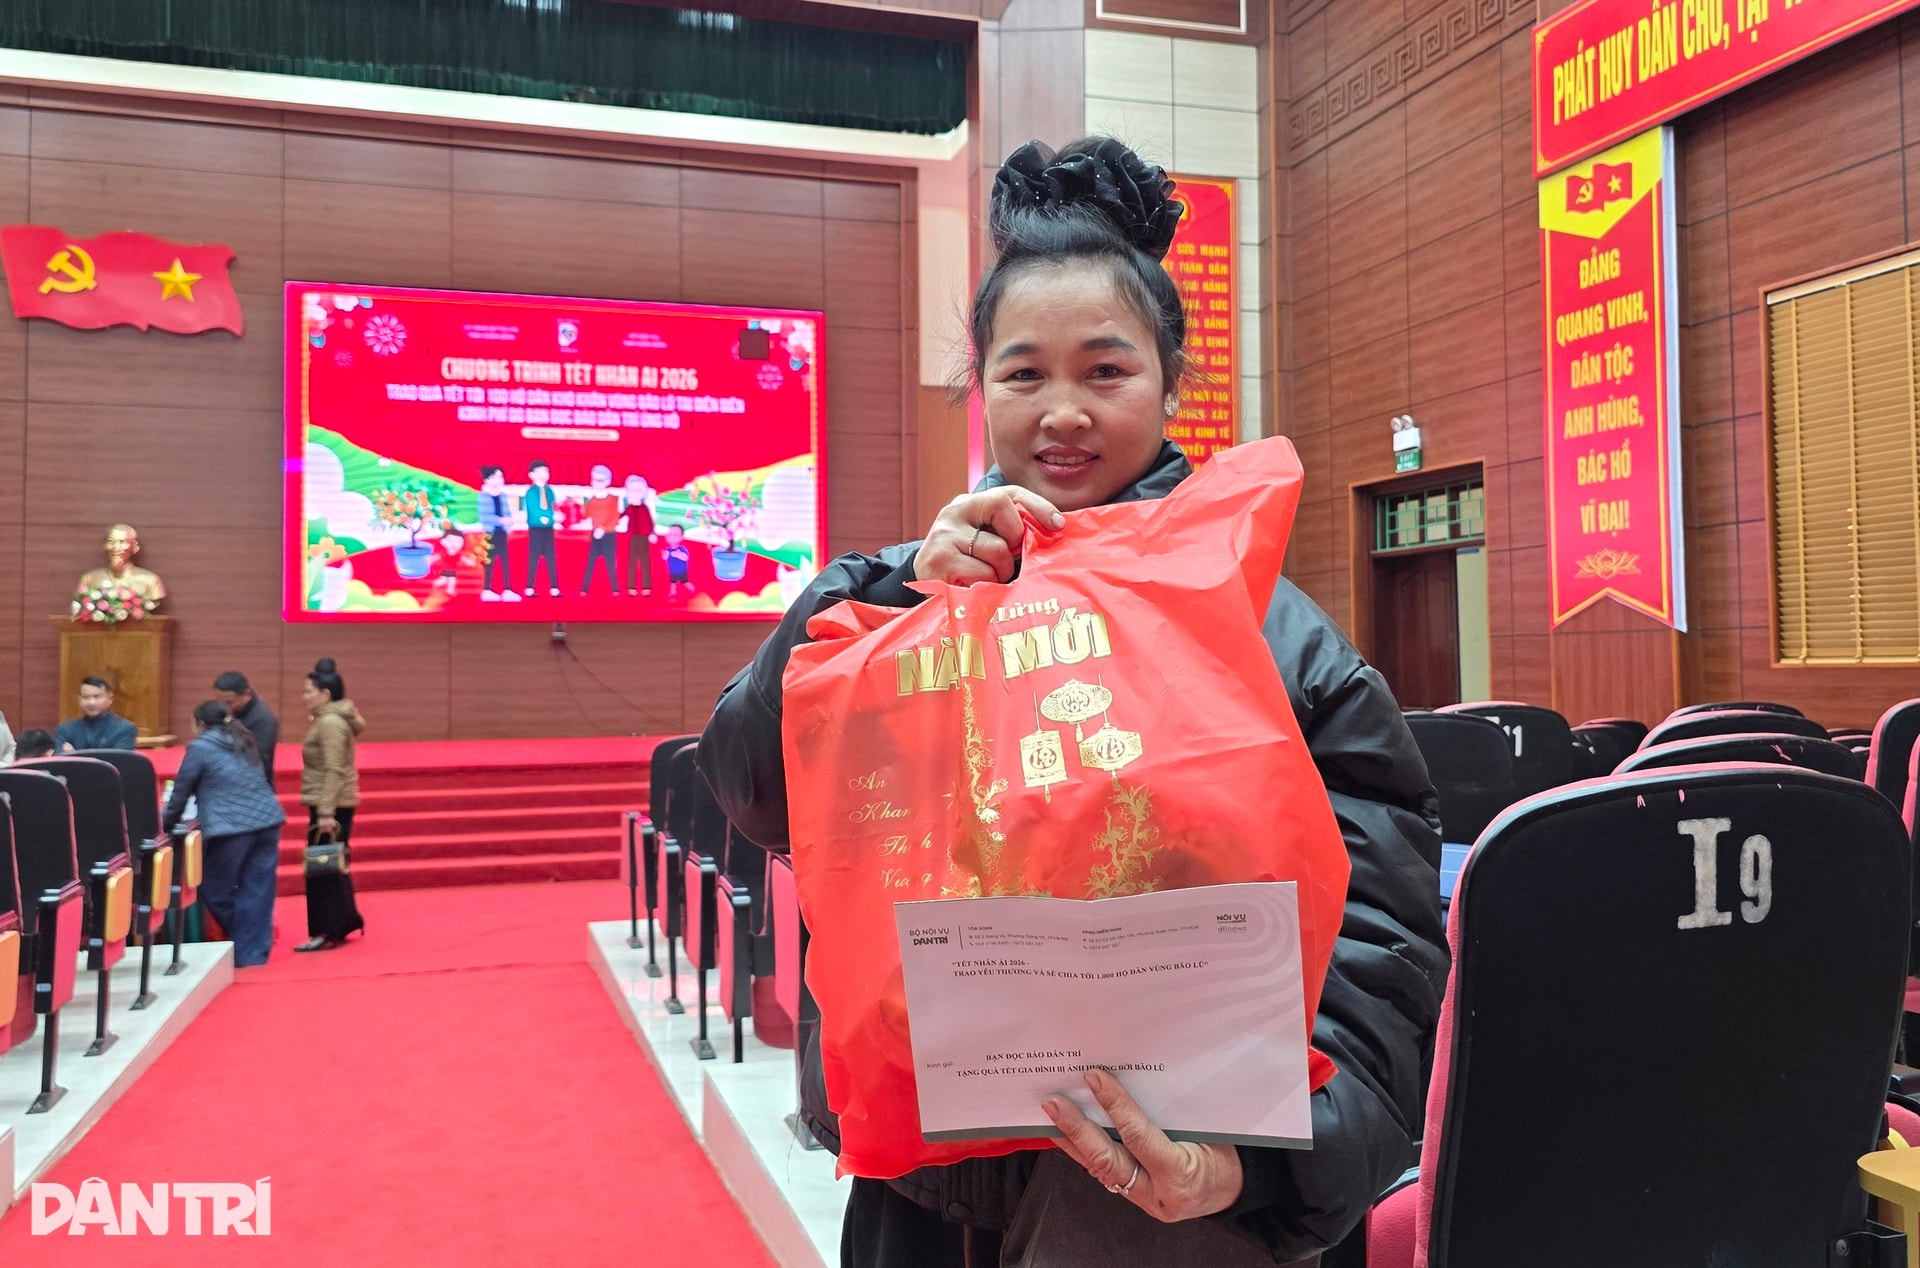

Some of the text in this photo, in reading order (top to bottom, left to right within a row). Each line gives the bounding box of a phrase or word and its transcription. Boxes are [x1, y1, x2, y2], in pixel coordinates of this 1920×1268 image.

[1553, 39, 1595, 126] PHÁT
[1599, 25, 1633, 103] HUY
[1638, 2, 1678, 83] DÂN
[1579, 246, 1621, 289] ĐẢNG
[1556, 290, 1648, 347] QUANG VINH,
[660, 367, 699, 390] 2026
[1571, 342, 1633, 389] DÂN TỘC
[1563, 394, 1644, 440] ANH HÙNG,
[1577, 437, 1632, 486] BÁC HỒ
[1580, 498, 1630, 537] VĨ ĐẠI!
[997, 607, 1112, 680] MỚI
[848, 770, 887, 791] An
[973, 958, 998, 967] NHÂN
[978, 968, 995, 976] YÊU
[1033, 968, 1045, 976] VÀ
[1058, 971, 1079, 979] CHIA
[1130, 965, 1147, 975] DÂN
[956, 1069, 980, 1078] TẶNG
[981, 1066, 999, 1076] QUÀ
[1000, 1065, 1017, 1074] TẾT
[1018, 1066, 1034, 1074] GIA
[1035, 1064, 1056, 1074] ĐÌNH
[1057, 1065, 1066, 1074] BỊ
[1134, 1063, 1152, 1071] BÃO
[1153, 1062, 1165, 1072] LŨ
[986, 1049, 1082, 1062] BẠN ĐỌC BÁO DÂN TRÍ
